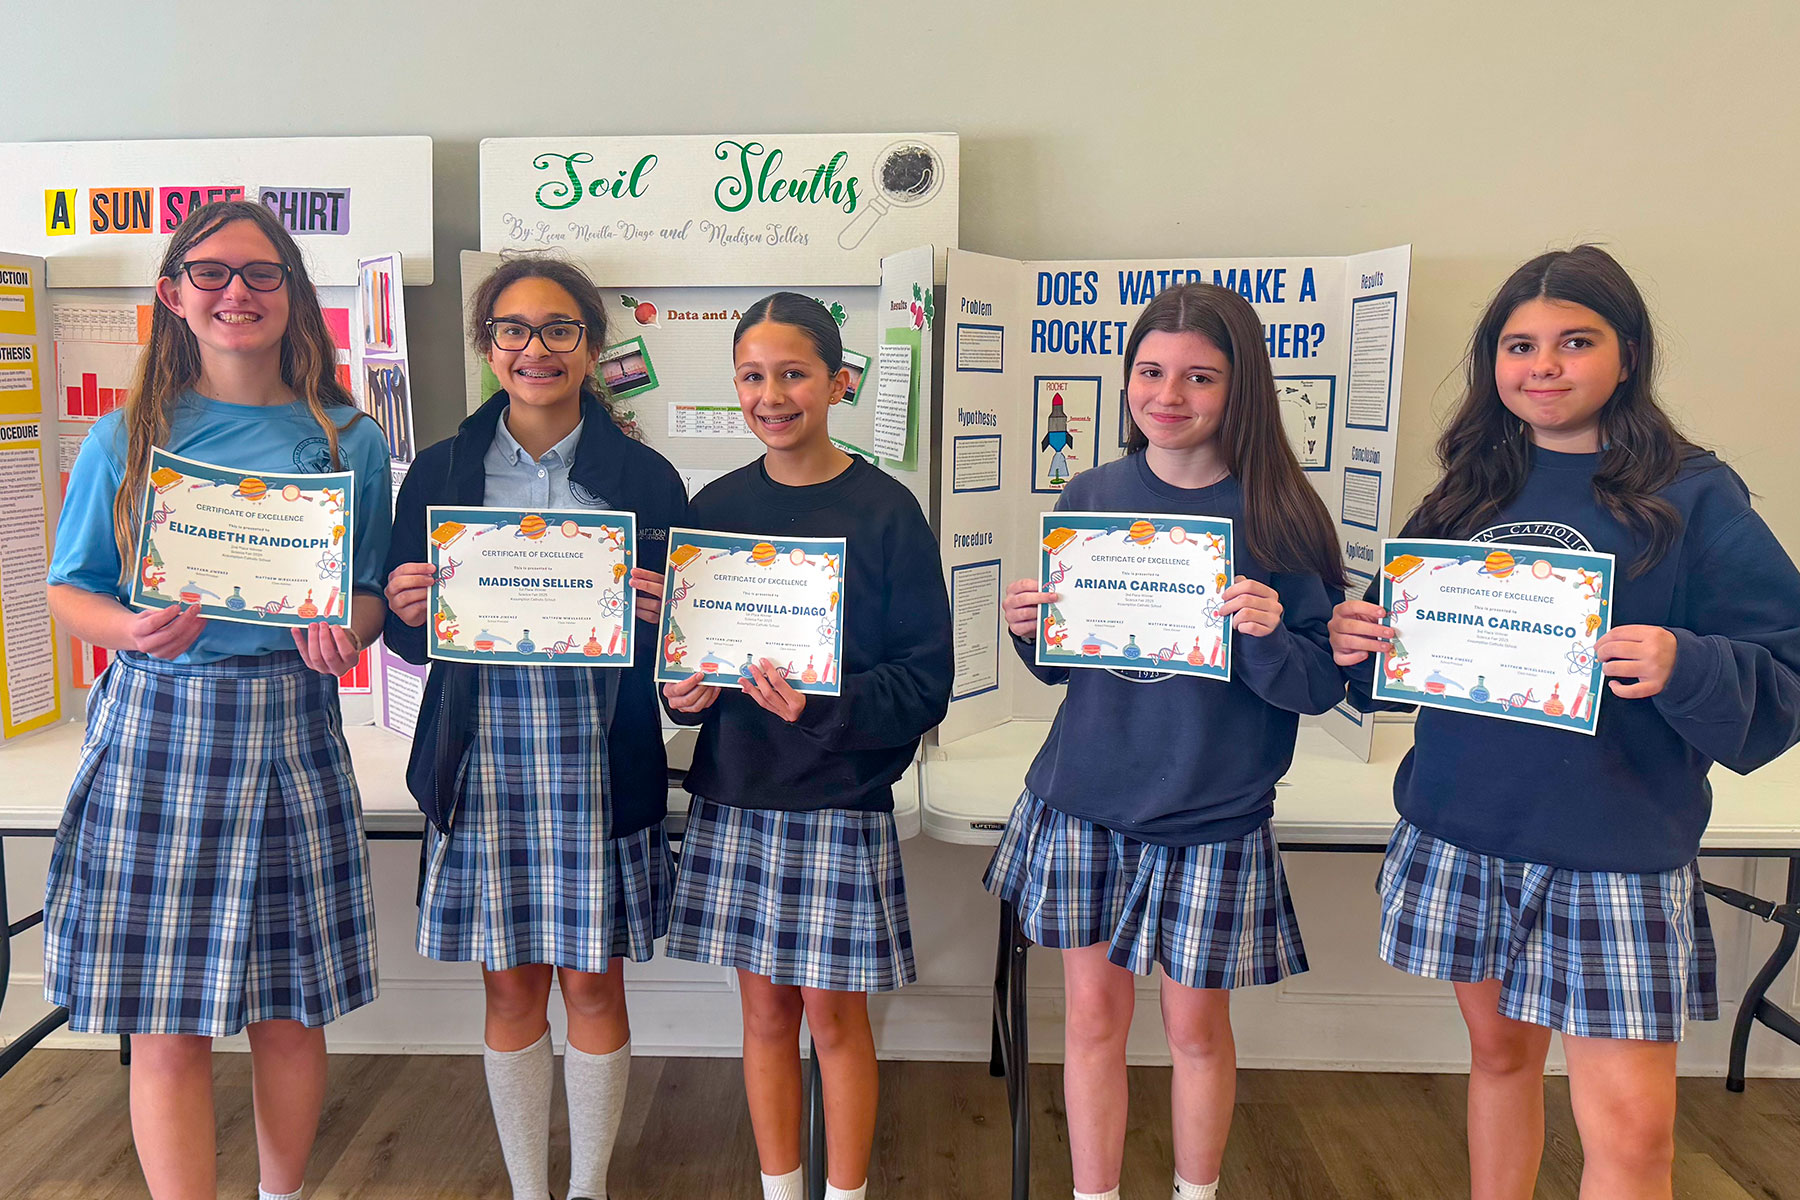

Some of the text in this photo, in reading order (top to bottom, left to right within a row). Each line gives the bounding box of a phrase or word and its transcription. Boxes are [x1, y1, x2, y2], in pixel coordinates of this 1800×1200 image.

[533, 140, 863, 214] Soil Sleuths
[51, 191, 71, 230] A
[93, 190, 151, 232] SUN
[660, 220, 693, 240] and
[765, 223, 809, 246] Sellers
[1037, 270, 1098, 306] DOES
[1299, 267, 1316, 303] A
[1360, 271, 1384, 289] Results
[667, 310, 698, 320] Data
[702, 310, 727, 320] and
[890, 300, 908, 312] Results
[961, 297, 992, 316] Problem
[1031, 320, 1128, 356] ROCKET
[1263, 322, 1326, 358] HER?
[1046, 382, 1068, 391] ROCKET
[958, 407, 997, 427] Hypothesis
[1351, 446, 1381, 464] Conclusion
[196, 503, 244, 518] CERTIFICATE
[257, 513, 304, 522] EXCELLENCE
[169, 521, 329, 549] ELIZABETH RANDOLPH
[953, 532, 993, 548] Procedure
[482, 550, 527, 558] CERTIFICATE
[1346, 540, 1374, 562] Application
[1091, 555, 1135, 563] CERTIFICATE
[1148, 557, 1190, 566] EXCELLENCE
[479, 577, 593, 589] MADISON SELLERS
[714, 574, 756, 583] CERTIFICATE
[768, 578, 807, 586] EXCELLENCE
[1074, 578, 1205, 595] ARIANA CARRASCO
[1440, 586, 1490, 597] CERTIFICATE
[1504, 592, 1554, 604] EXCELLENCE
[693, 599, 826, 616] LEONA MOVILLA-DIAGO
[1415, 609, 1576, 638] SABRINA CARRASCO
